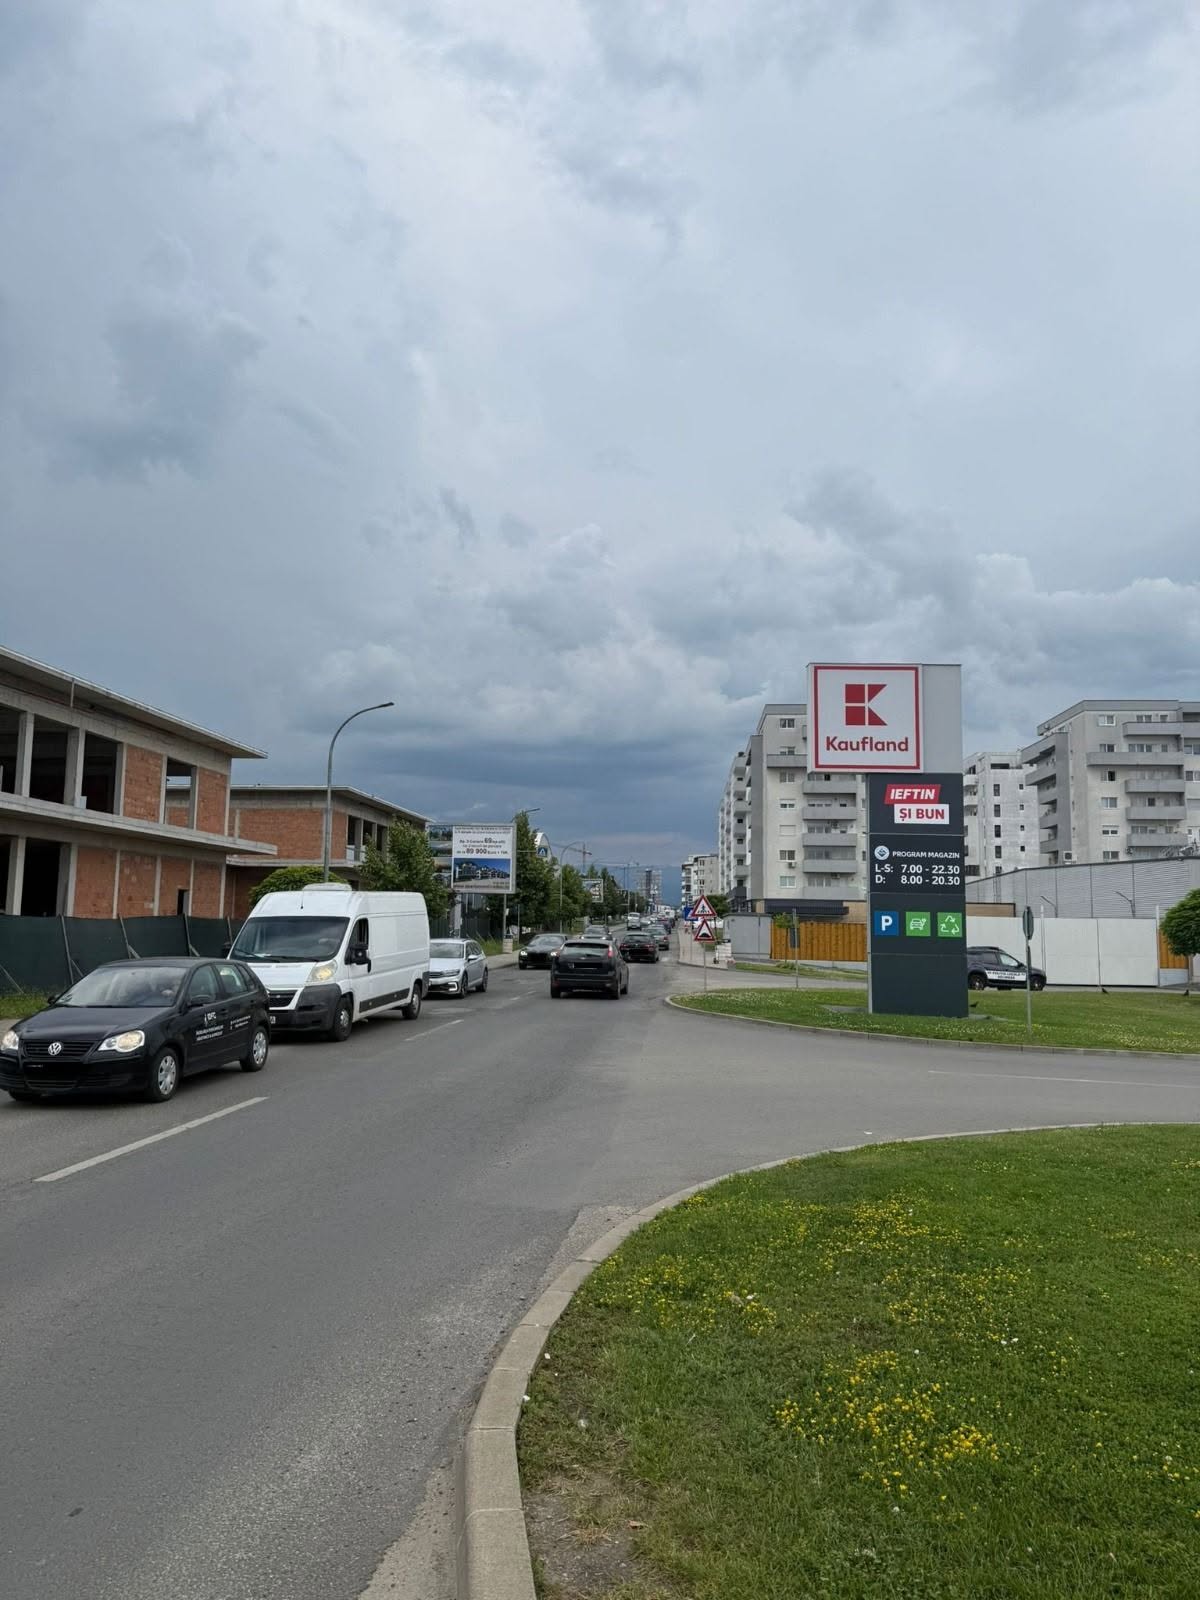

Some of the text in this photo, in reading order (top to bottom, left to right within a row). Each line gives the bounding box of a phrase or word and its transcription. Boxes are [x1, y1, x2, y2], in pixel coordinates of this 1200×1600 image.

[826, 736, 909, 752] Kaufland
[890, 788, 936, 800] IEFTIN
[899, 808, 945, 822] ȘI BUN
[892, 850, 927, 858] PROGRAM
[875, 863, 894, 873] L-S:
[900, 864, 923, 874] 7.00
[931, 865, 960, 874] 22.30
[875, 874, 886, 884] D:
[900, 875, 923, 884] 8.00
[931, 876, 961, 885] 20.30
[881, 915, 893, 931] P
